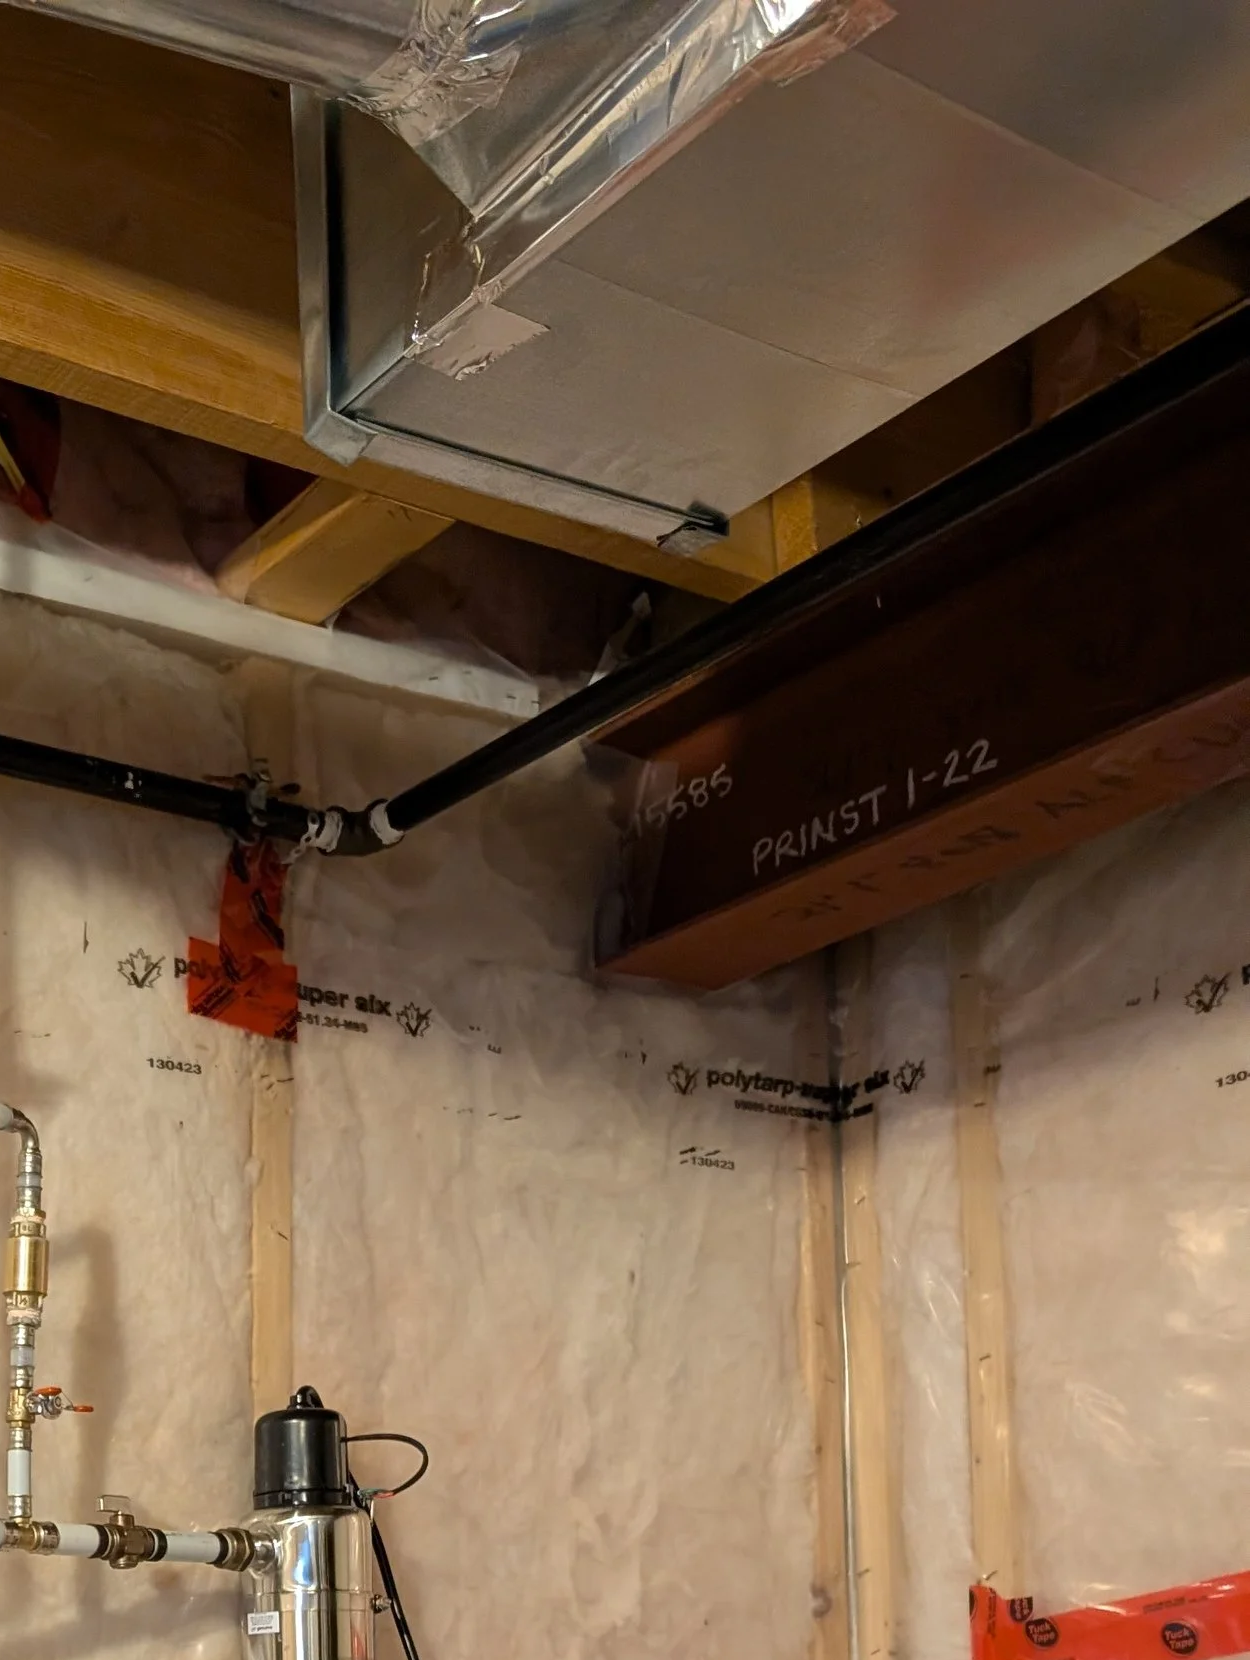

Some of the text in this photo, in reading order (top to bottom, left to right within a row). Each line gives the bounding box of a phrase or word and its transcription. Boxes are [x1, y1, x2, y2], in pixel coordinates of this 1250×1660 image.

[752, 739, 998, 876] PRINST 1-22
[354, 994, 392, 1017] six
[146, 1057, 202, 1075] 130423
[1215, 1069, 1250, 1088] 130
